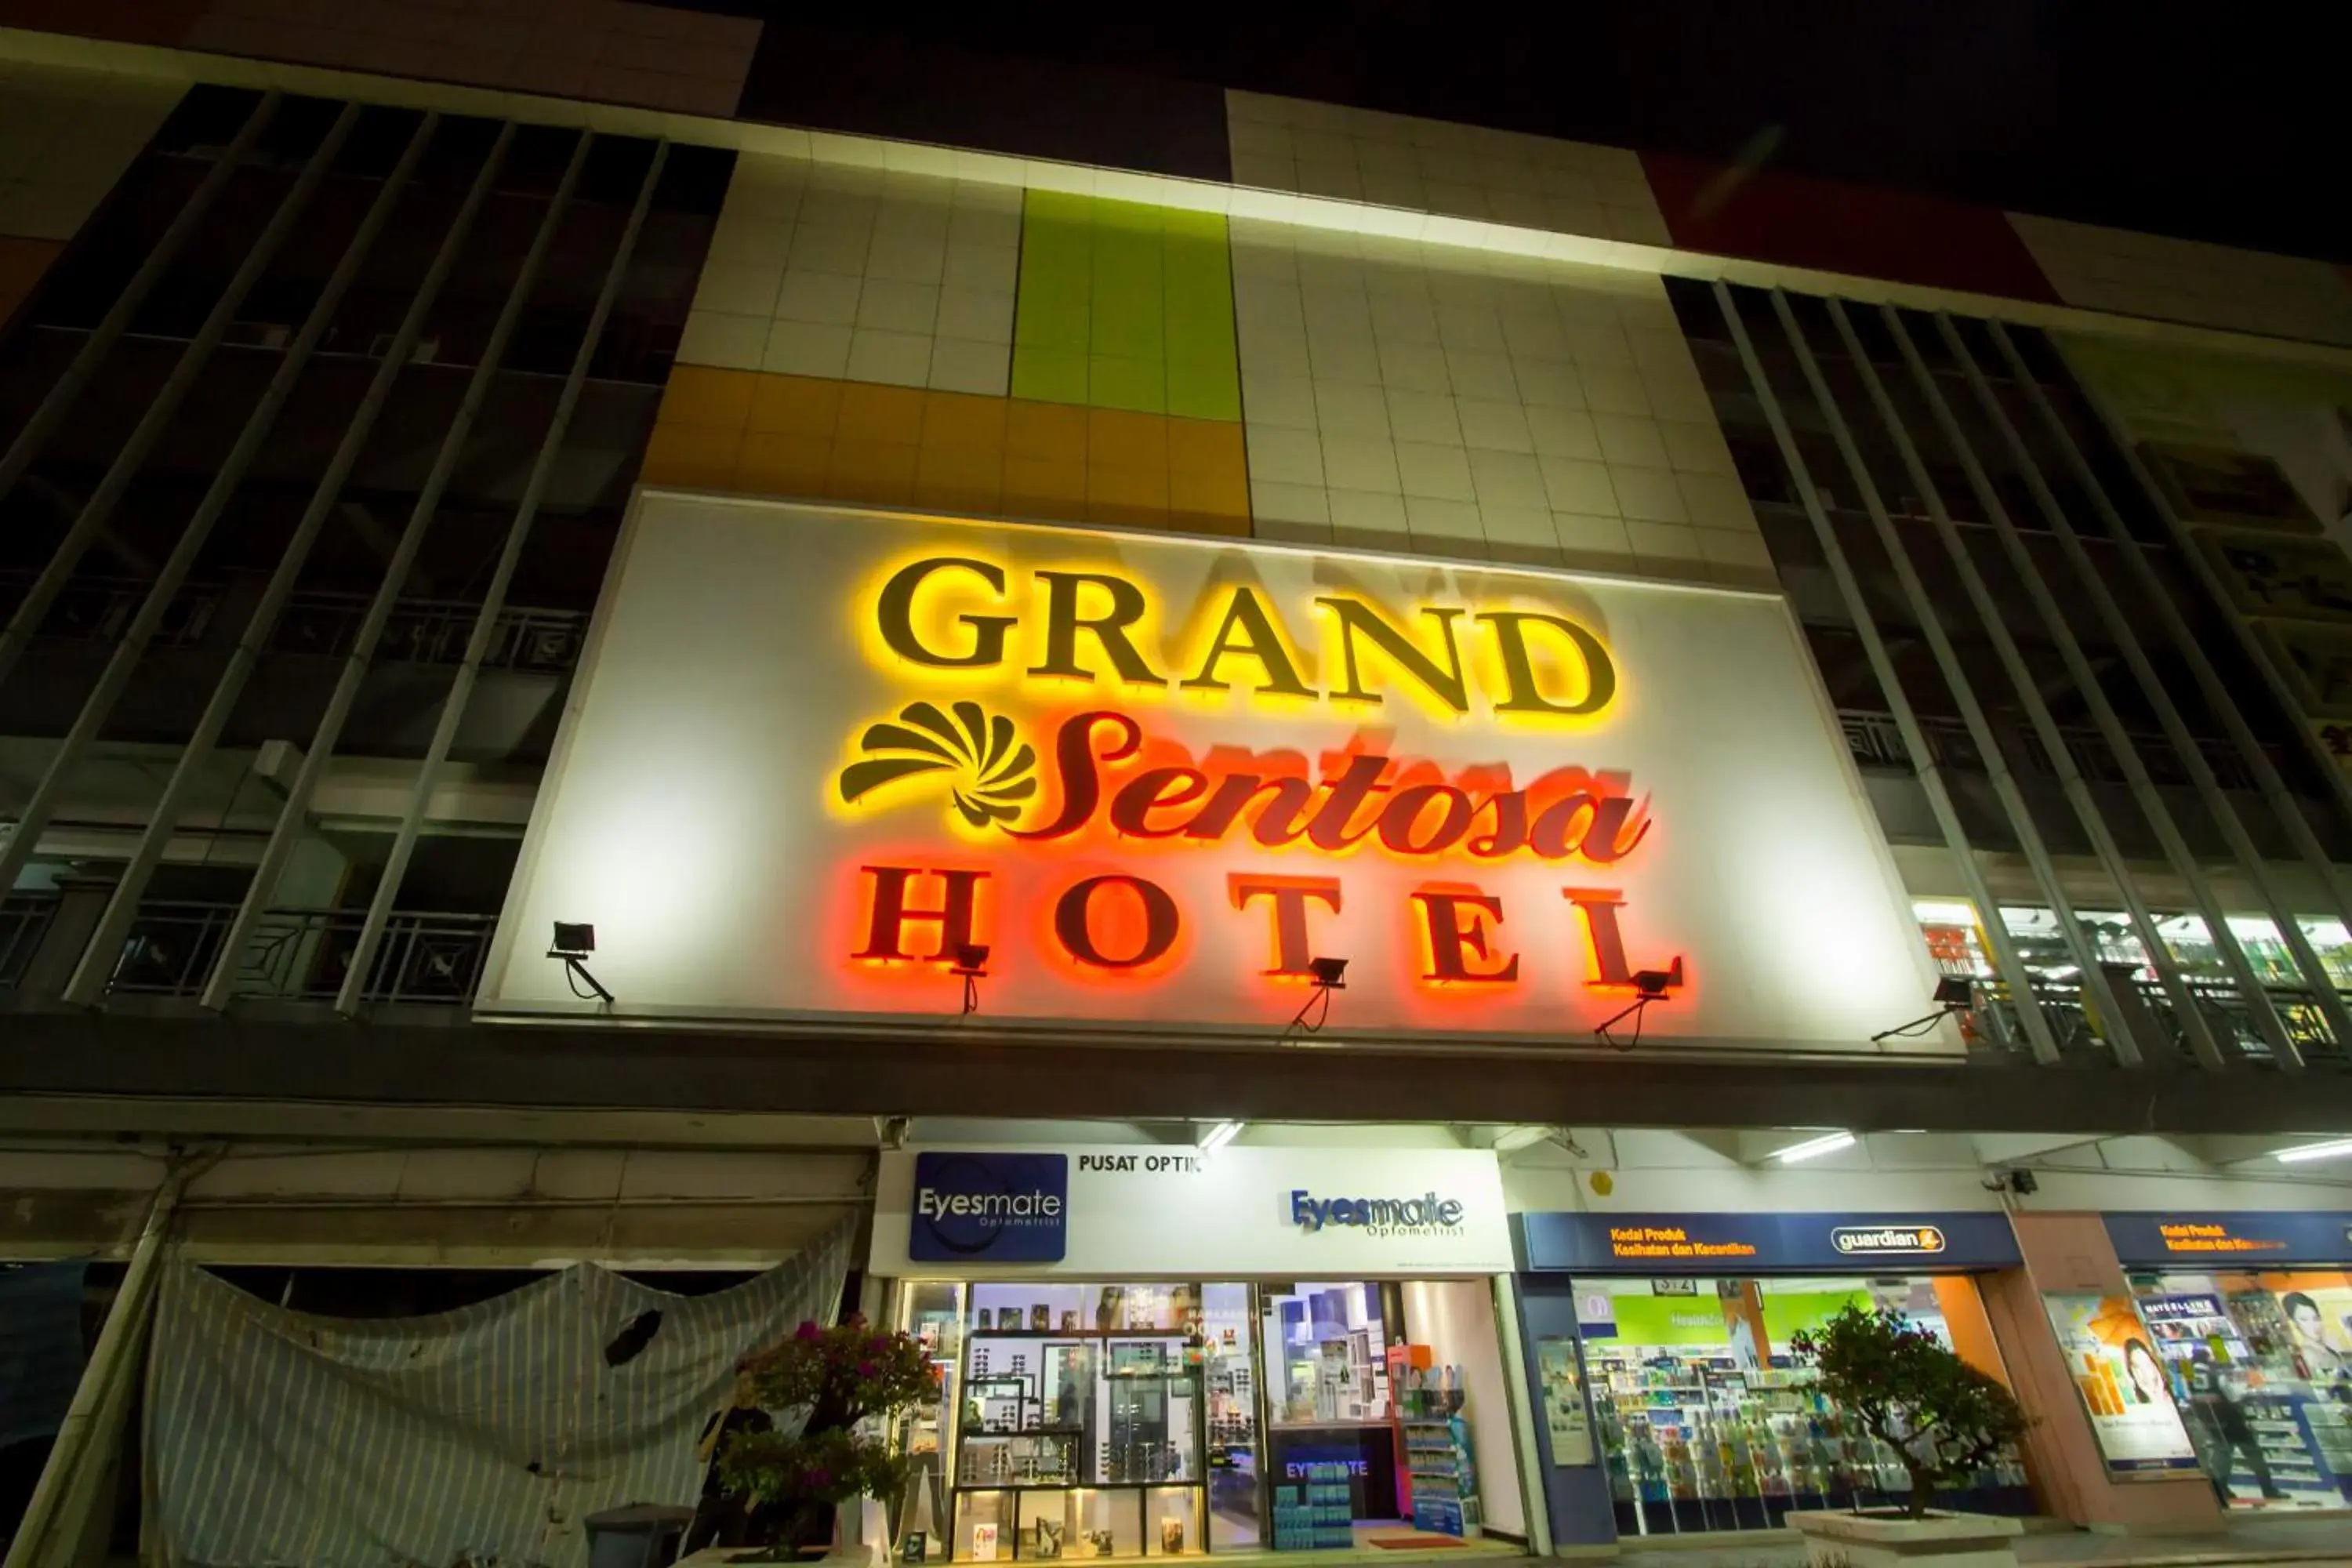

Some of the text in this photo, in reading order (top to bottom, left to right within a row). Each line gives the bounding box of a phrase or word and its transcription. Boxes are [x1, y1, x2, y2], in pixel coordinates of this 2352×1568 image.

[877, 557, 1617, 717] GRAND
[1000, 710, 1651, 863] Sentosa
[851, 866, 1683, 986] HOTEL
[1079, 1155, 1138, 1171] PUSAT
[918, 1188, 1062, 1221] Eyesmate
[1291, 1189, 1464, 1232] Eyesmate
[979, 1216, 1061, 1228] Optometrist
[1367, 1225, 1465, 1238] Optometrist
[1610, 1228, 1686, 1241] Kedai Produk
[1838, 1230, 1918, 1250] guardian
[1613, 1243, 1670, 1256] Kesihatan
[1671, 1243, 1693, 1256] dan
